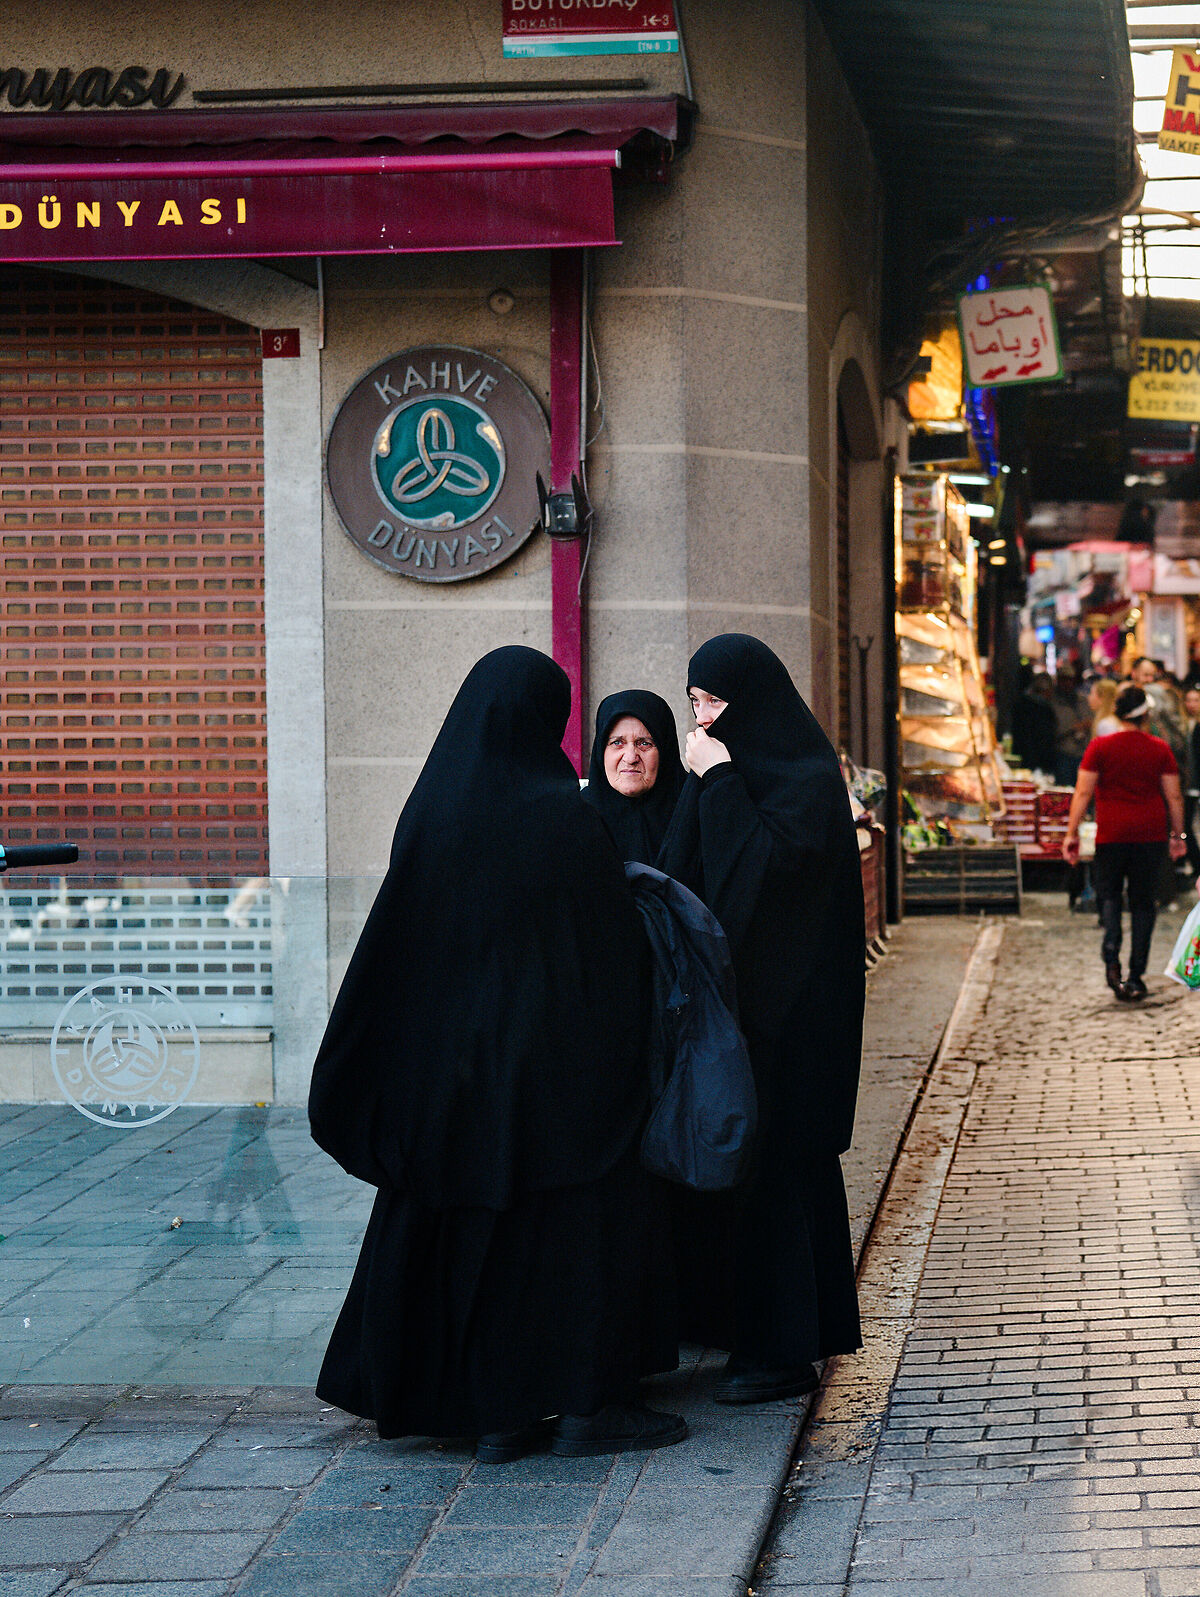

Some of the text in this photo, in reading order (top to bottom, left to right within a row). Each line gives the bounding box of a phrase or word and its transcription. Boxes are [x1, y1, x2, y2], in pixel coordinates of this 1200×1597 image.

[0, 195, 247, 231] DÜNYASI
[976, 300, 1035, 328] محل
[968, 317, 1050, 359] أوباما
[374, 361, 499, 404] KAHVE
[367, 515, 515, 569] DÜNYASI
[66, 988, 184, 1037] KAHVE
[66, 1066, 185, 1117] DÜNYASI
